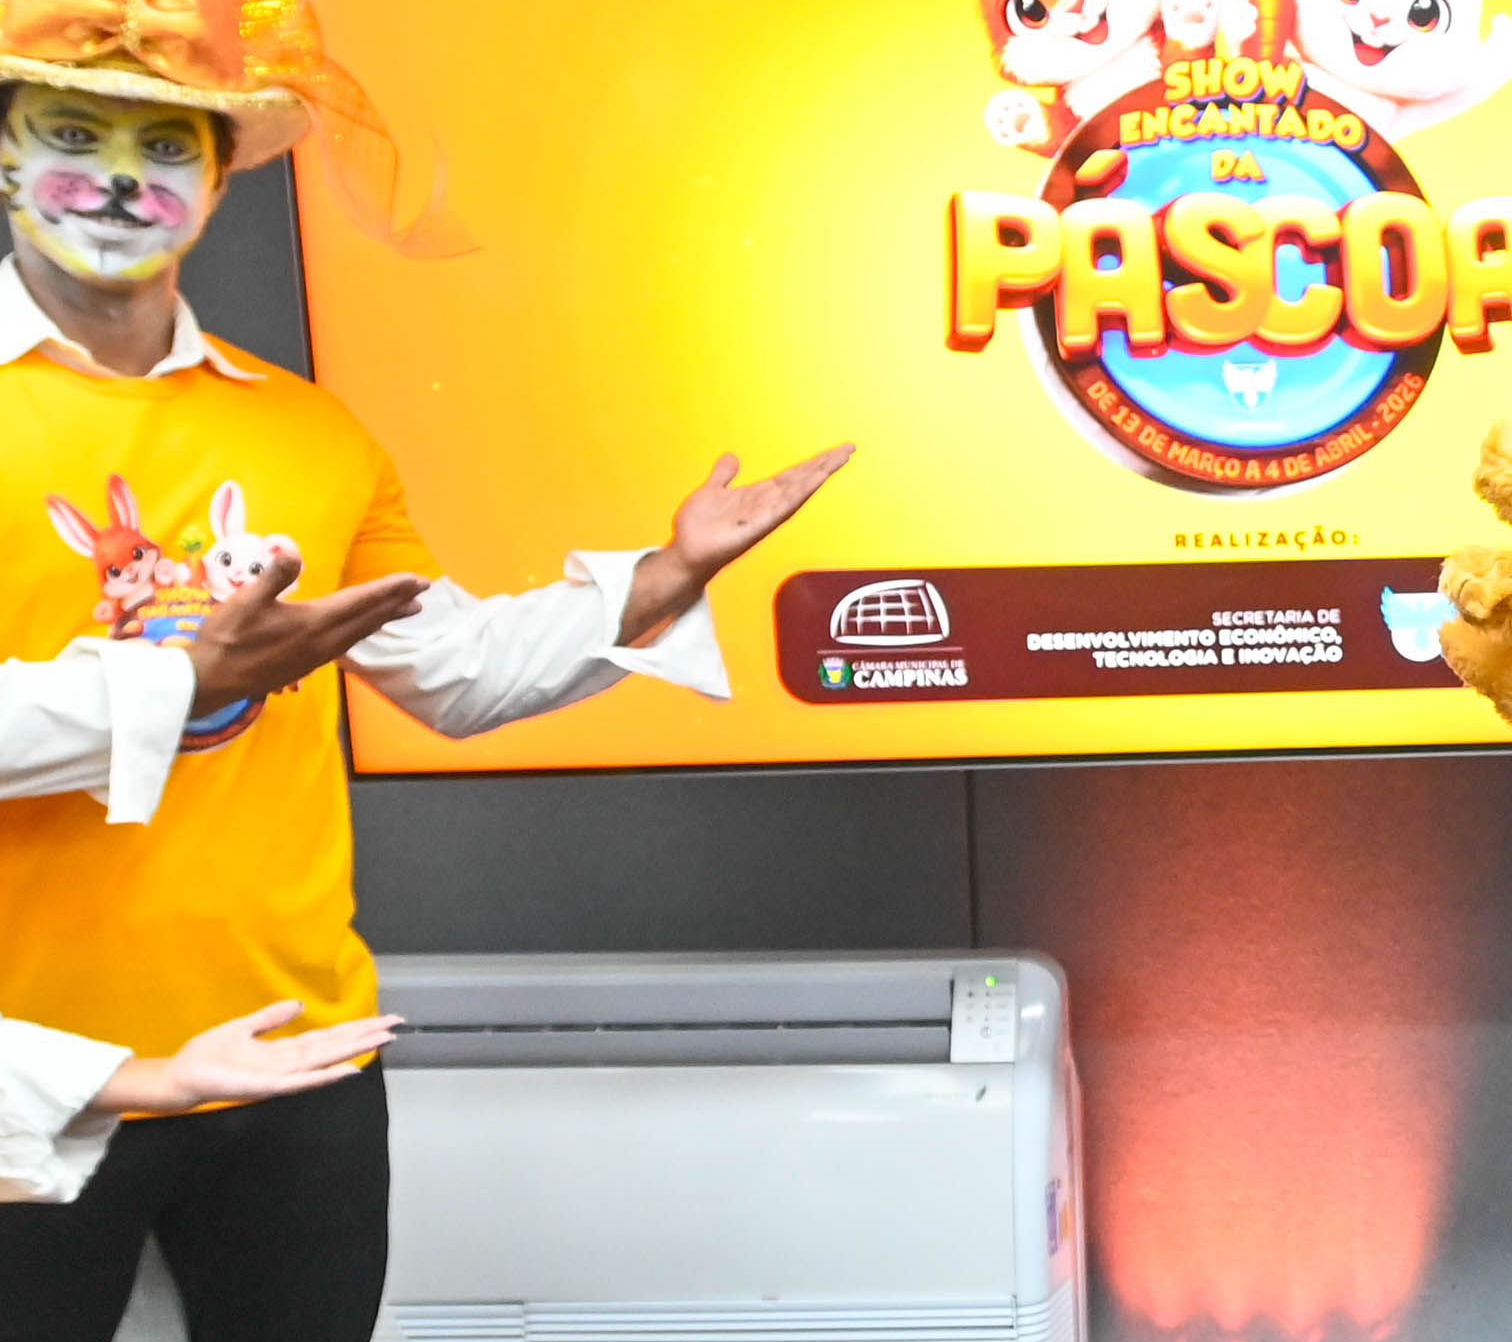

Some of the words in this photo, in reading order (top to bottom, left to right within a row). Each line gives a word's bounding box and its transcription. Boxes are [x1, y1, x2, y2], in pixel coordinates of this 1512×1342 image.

[1163, 56, 1307, 107] SHOW
[1119, 101, 1369, 153] ENCANTADO
[1211, 148, 1267, 185] DA
[1086, 379, 1116, 410] DE
[1110, 406, 1141, 434] 13
[1138, 426, 1171, 454] DE
[1167, 442, 1241, 479] MARÇO
[1244, 459, 1262, 480] A
[1265, 459, 1279, 480] 4
[1283, 451, 1313, 477] DE
[1314, 422, 1375, 468] ABRIL
[1377, 371, 1425, 424] 2026
[1174, 525, 1360, 552] REALIZAÇÃO:
[1211, 609, 1315, 627] SECRETARIA
[1317, 608, 1341, 625] DE
[1026, 629, 1216, 651] DESENVOLVIMENTO
[1218, 624, 1344, 647] ECONÔMICO,
[852, 660, 893, 670] CÂMARA
[894, 660, 948, 669] MUNICIPAL
[950, 659, 965, 668] DE
[1091, 648, 1219, 669] TECNOLOGIA
[1221, 648, 1236, 665] E
[1239, 643, 1344, 666] INOVAÇÃO
[853, 668, 968, 689] CAMPINAS
